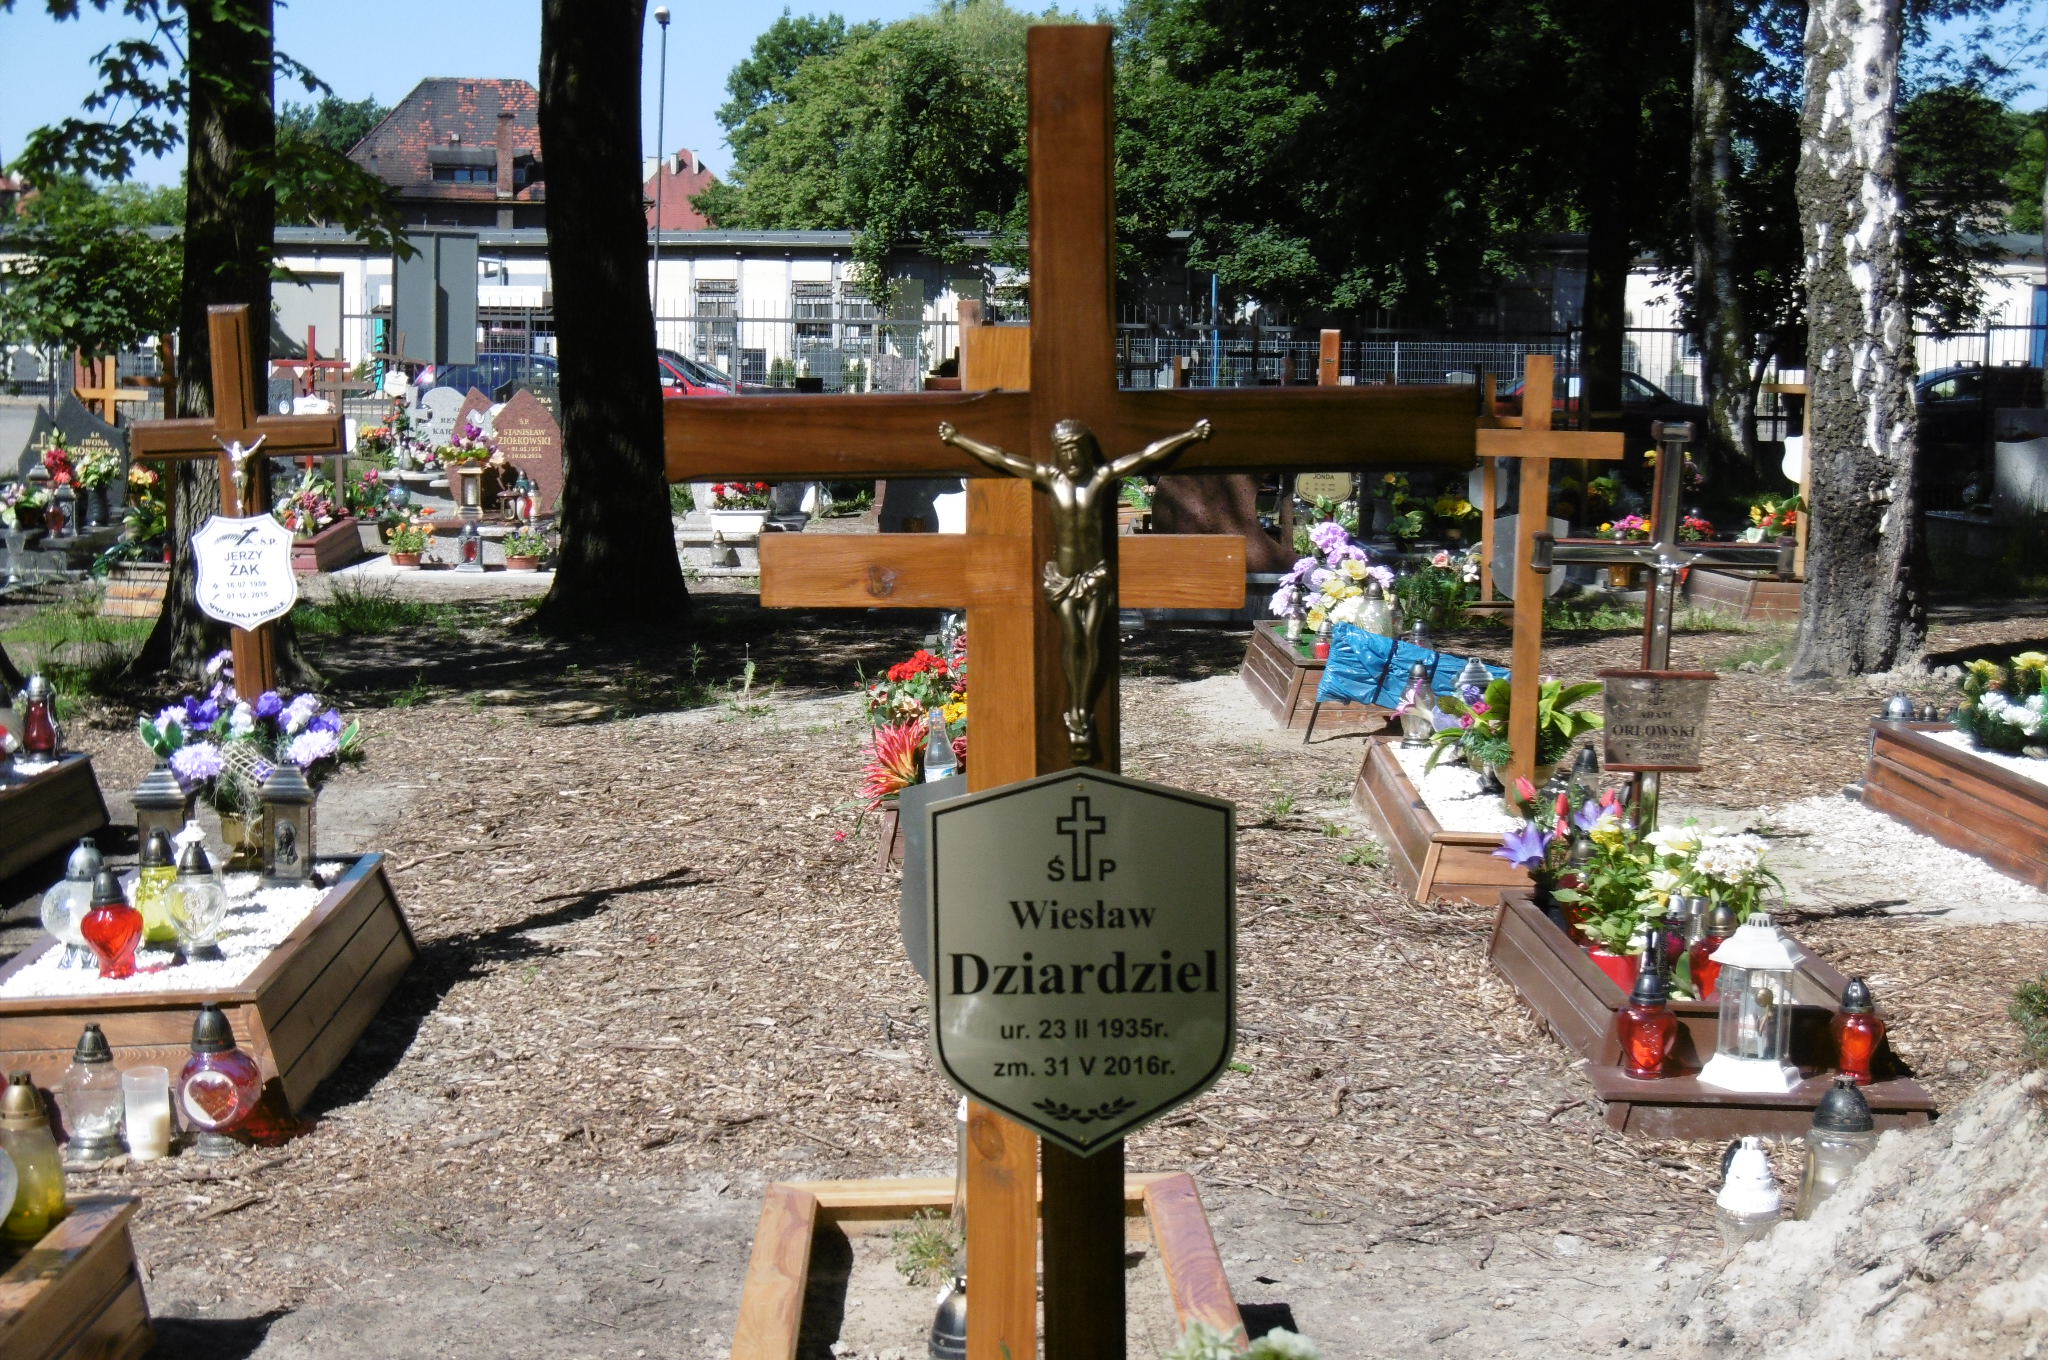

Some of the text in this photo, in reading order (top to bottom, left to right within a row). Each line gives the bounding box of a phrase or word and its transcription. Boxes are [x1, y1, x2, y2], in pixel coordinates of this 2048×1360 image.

[81, 438, 109, 446] IWONA
[224, 550, 263, 562] JERZY
[229, 562, 260, 576] ŻAK
[1099, 859, 1117, 881] P
[1009, 899, 1157, 930] Wiesław
[947, 949, 1220, 997] Dziardziel
[1000, 1018, 1169, 1040] ur. 23 II 1935r.
[993, 1056, 1176, 1077] zm. 31 V 2016r.
